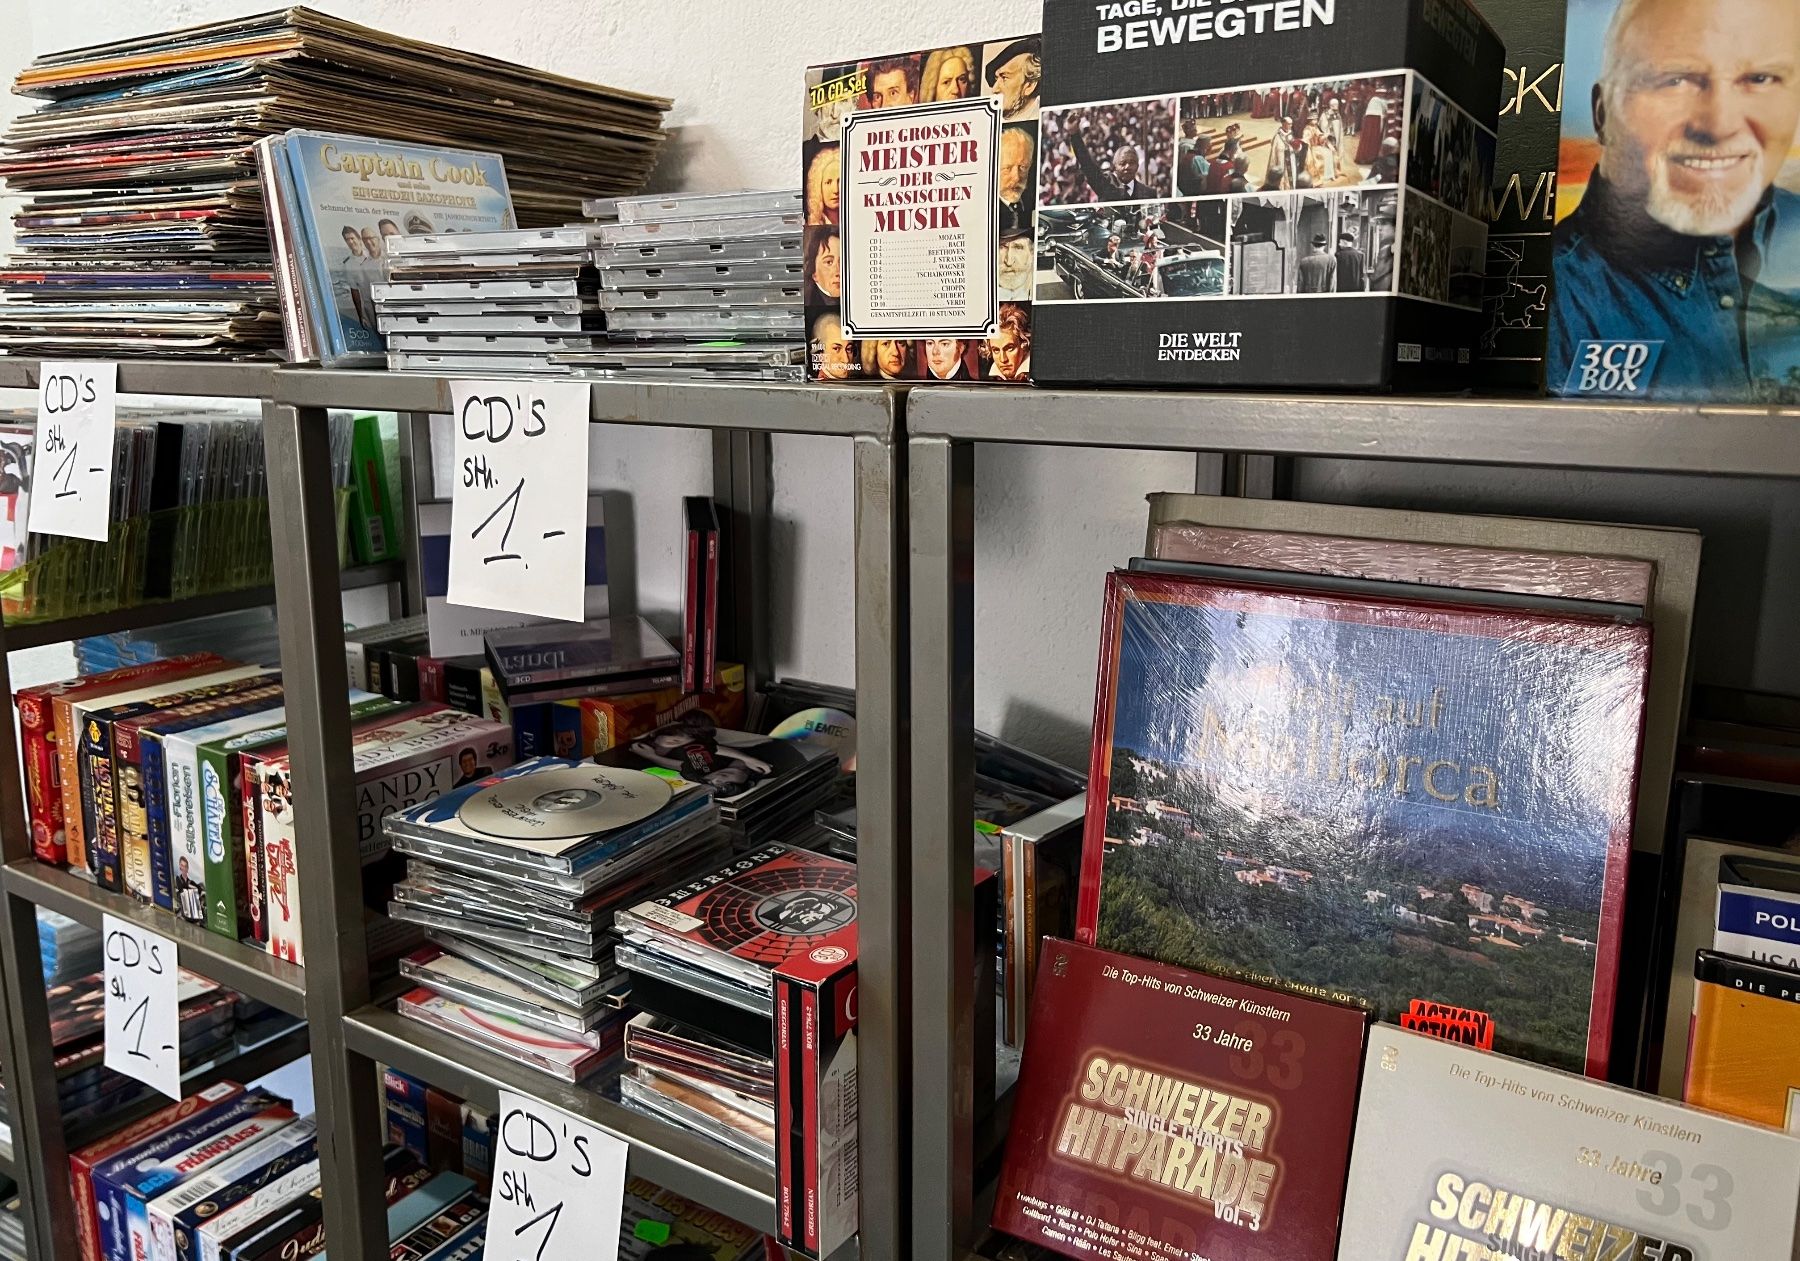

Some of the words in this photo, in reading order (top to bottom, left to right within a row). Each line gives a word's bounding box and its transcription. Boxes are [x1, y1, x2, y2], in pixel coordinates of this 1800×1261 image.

[1096, 0, 1162, 20] TAGE,
[1097, 0, 1335, 53] BEWEGTEN
[811, 88, 825, 106] 10
[827, 75, 867, 101] CD-Set
[867, 129, 894, 146] DIE
[898, 122, 972, 142] GROSSEN
[320, 143, 424, 181] Captain
[429, 157, 488, 187] Cook
[859, 140, 978, 173] MEISTER
[900, 172, 933, 187] DER
[864, 186, 972, 208] KLASSISCHEN
[874, 205, 961, 233] MUSIK
[928, 248, 966, 256] BEETHOVEN
[938, 233, 966, 241] MOZART
[940, 277, 966, 285] VIVALDI
[941, 284, 966, 292] CHOPIN
[349, 328, 370, 339] 5CD
[1159, 333, 1188, 348] DIE
[1193, 332, 1242, 348] WELT
[1157, 348, 1241, 362] ENTDECKEN
[1580, 344, 1648, 370] 3CD
[1578, 368, 1641, 391] BOX
[814, 722, 849, 738] EMTEC
[172, 761, 180, 817] Florian
[358, 763, 442, 811] ANDY
[182, 764, 197, 855] Silbereisen
[204, 768, 224, 858] SCHÄFER
[243, 796, 255, 848] Cook
[245, 850, 260, 921] Captain
[655, 846, 787, 907] OWERZONE
[1756, 912, 1800, 932] POL
[1102, 964, 1119, 981] Die
[1121, 968, 1162, 991] Top-Hits
[1163, 981, 1182, 995] von
[1184, 985, 1239, 1010] Schweizer
[1239, 998, 1291, 1022] Künstlern
[1736, 978, 1765, 993] DIE
[1192, 1023, 1211, 1041] 33
[1213, 1028, 1254, 1053] Jahre
[1081, 1057, 1271, 1151] SCHWEIZER
[1449, 1062, 1471, 1081] Die
[1473, 1069, 1526, 1097] Top-Hits
[1530, 1087, 1555, 1105] von
[1557, 1093, 1631, 1124] Schweizer
[1634, 1111, 1702, 1144] Künstlern
[175, 1122, 265, 1174] FRANÇAISE
[1123, 1107, 1182, 1138] SINGLE
[1181, 1124, 1245, 1160] CHARTS
[1057, 1103, 1277, 1216] HITPARADE
[1575, 1146, 1601, 1169] 33
[1605, 1154, 1663, 1186] Jahre
[1636, 1150, 1735, 1232] 33
[807, 1188, 815, 1236] GREGORIAN
[1213, 1199, 1244, 1227] Vol.
[1248, 1212, 1261, 1233] 3
[1022, 1205, 1052, 1223] Gotthard
[1058, 1217, 1076, 1233] Tears
[1084, 1226, 1099, 1239] Polo
[1099, 1230, 1120, 1247] Hofer
[1127, 1241, 1143, 1256] Sina
[1086, 1215, 1096, 1225] DJ
[1147, 1235, 1163, 1249] feat.
[1487, 1233, 1565, 1261] SING
[1098, 1245, 1111, 1258] Les
